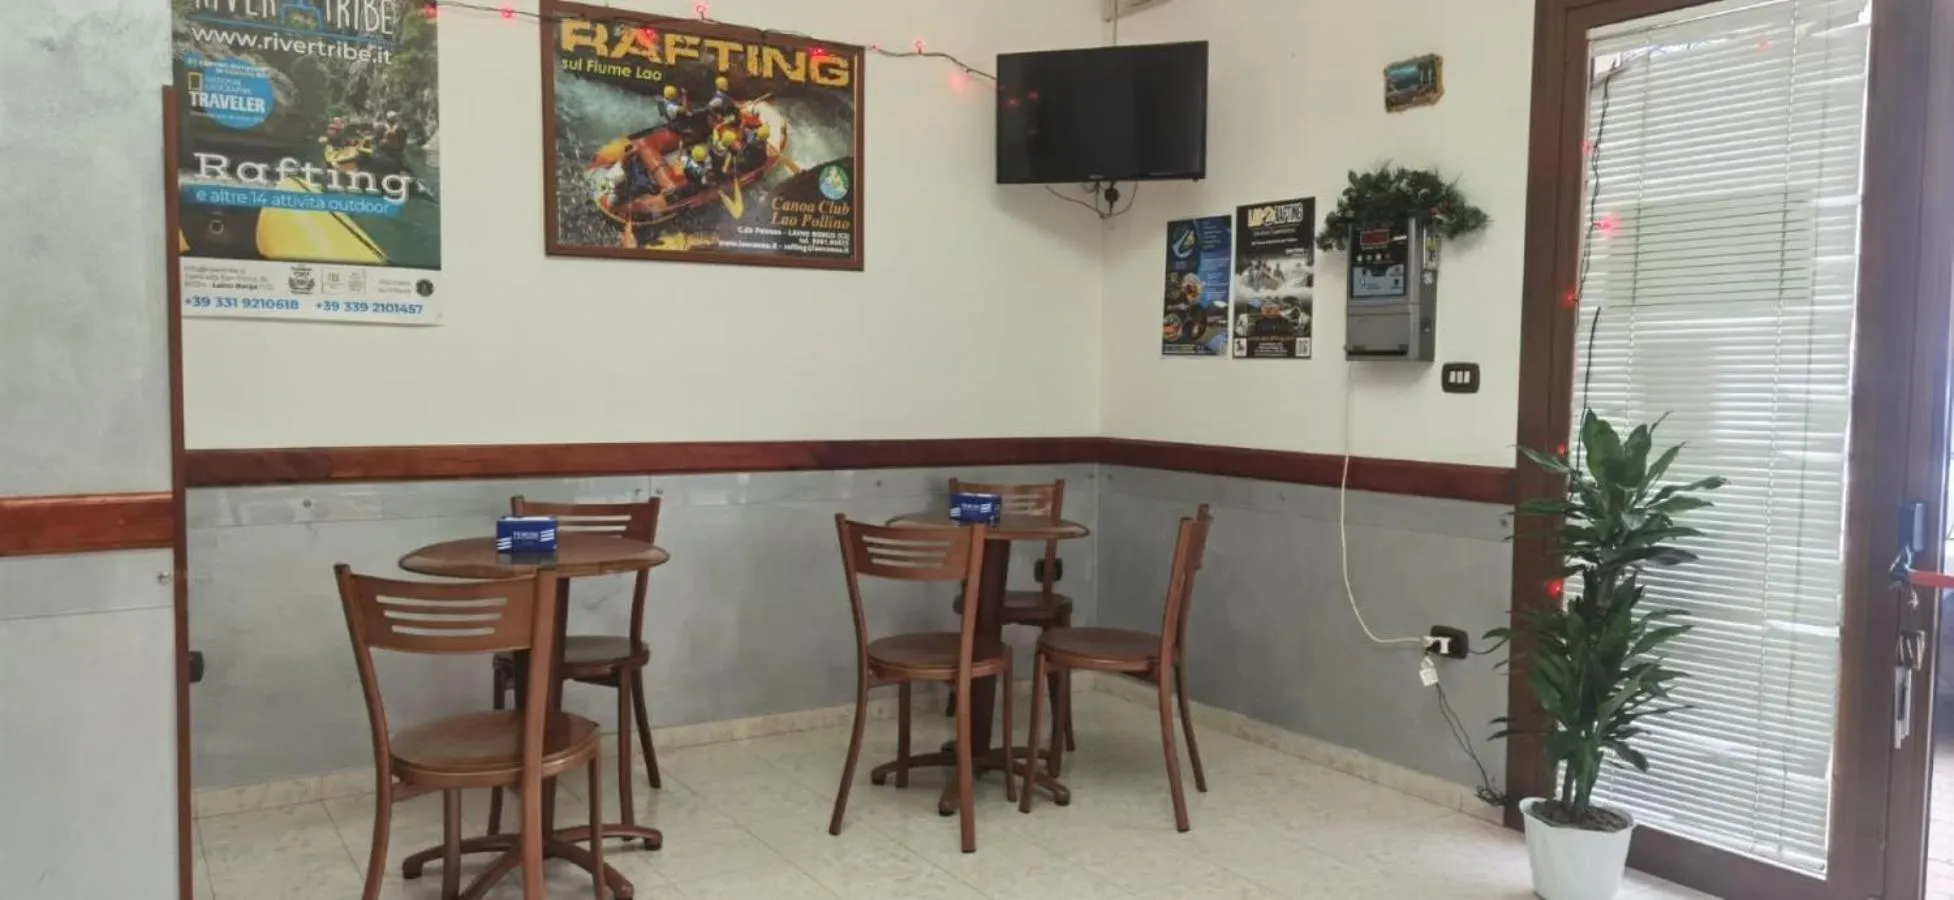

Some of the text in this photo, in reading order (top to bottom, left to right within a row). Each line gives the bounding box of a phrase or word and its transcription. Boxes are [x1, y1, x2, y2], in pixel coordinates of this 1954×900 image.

[191, 26, 393, 65] www.rivertribe.it
[561, 18, 850, 87] RAFTING
[562, 58, 663, 82] sul Fiume Lao
[188, 91, 266, 113] TRAVELER
[193, 152, 414, 204] Rafting
[196, 189, 389, 213] e altre 14 attività outdoor
[771, 196, 850, 215] Canoa Club
[771, 211, 850, 230] Lao Pollino
[185, 295, 211, 308] +39
[215, 297, 238, 308] 331
[316, 301, 424, 315] +39 339 2101457
